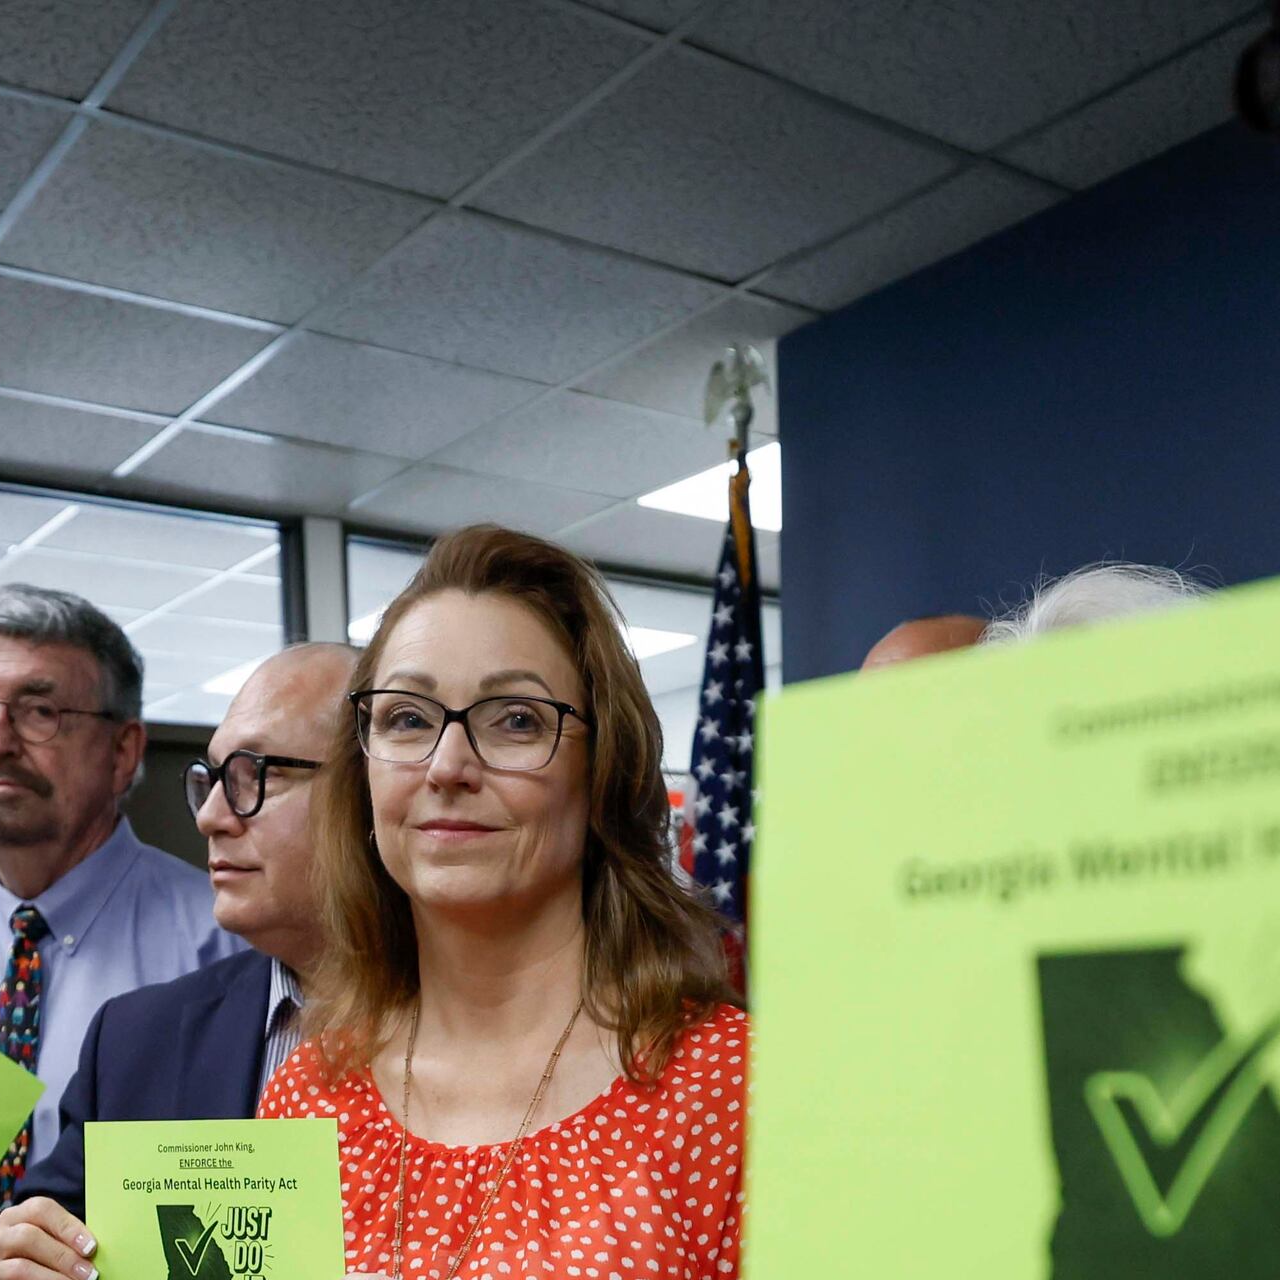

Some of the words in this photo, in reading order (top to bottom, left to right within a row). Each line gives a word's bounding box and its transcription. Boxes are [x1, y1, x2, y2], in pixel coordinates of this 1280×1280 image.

[897, 847, 1056, 905] Georgia
[1066, 832, 1232, 884] Mental
[157, 1143, 213, 1153] Commissioner
[214, 1142, 234, 1152] John
[179, 1158, 217, 1168] ENFORCE
[218, 1158, 233, 1168] the
[122, 1178, 161, 1193] Georgia
[164, 1177, 201, 1190] Mental
[204, 1177, 241, 1190] Health
[244, 1176, 276, 1193] Parity
[278, 1177, 298, 1190] Act
[221, 1206, 272, 1240] JUST
[234, 1240, 263, 1274] DO
